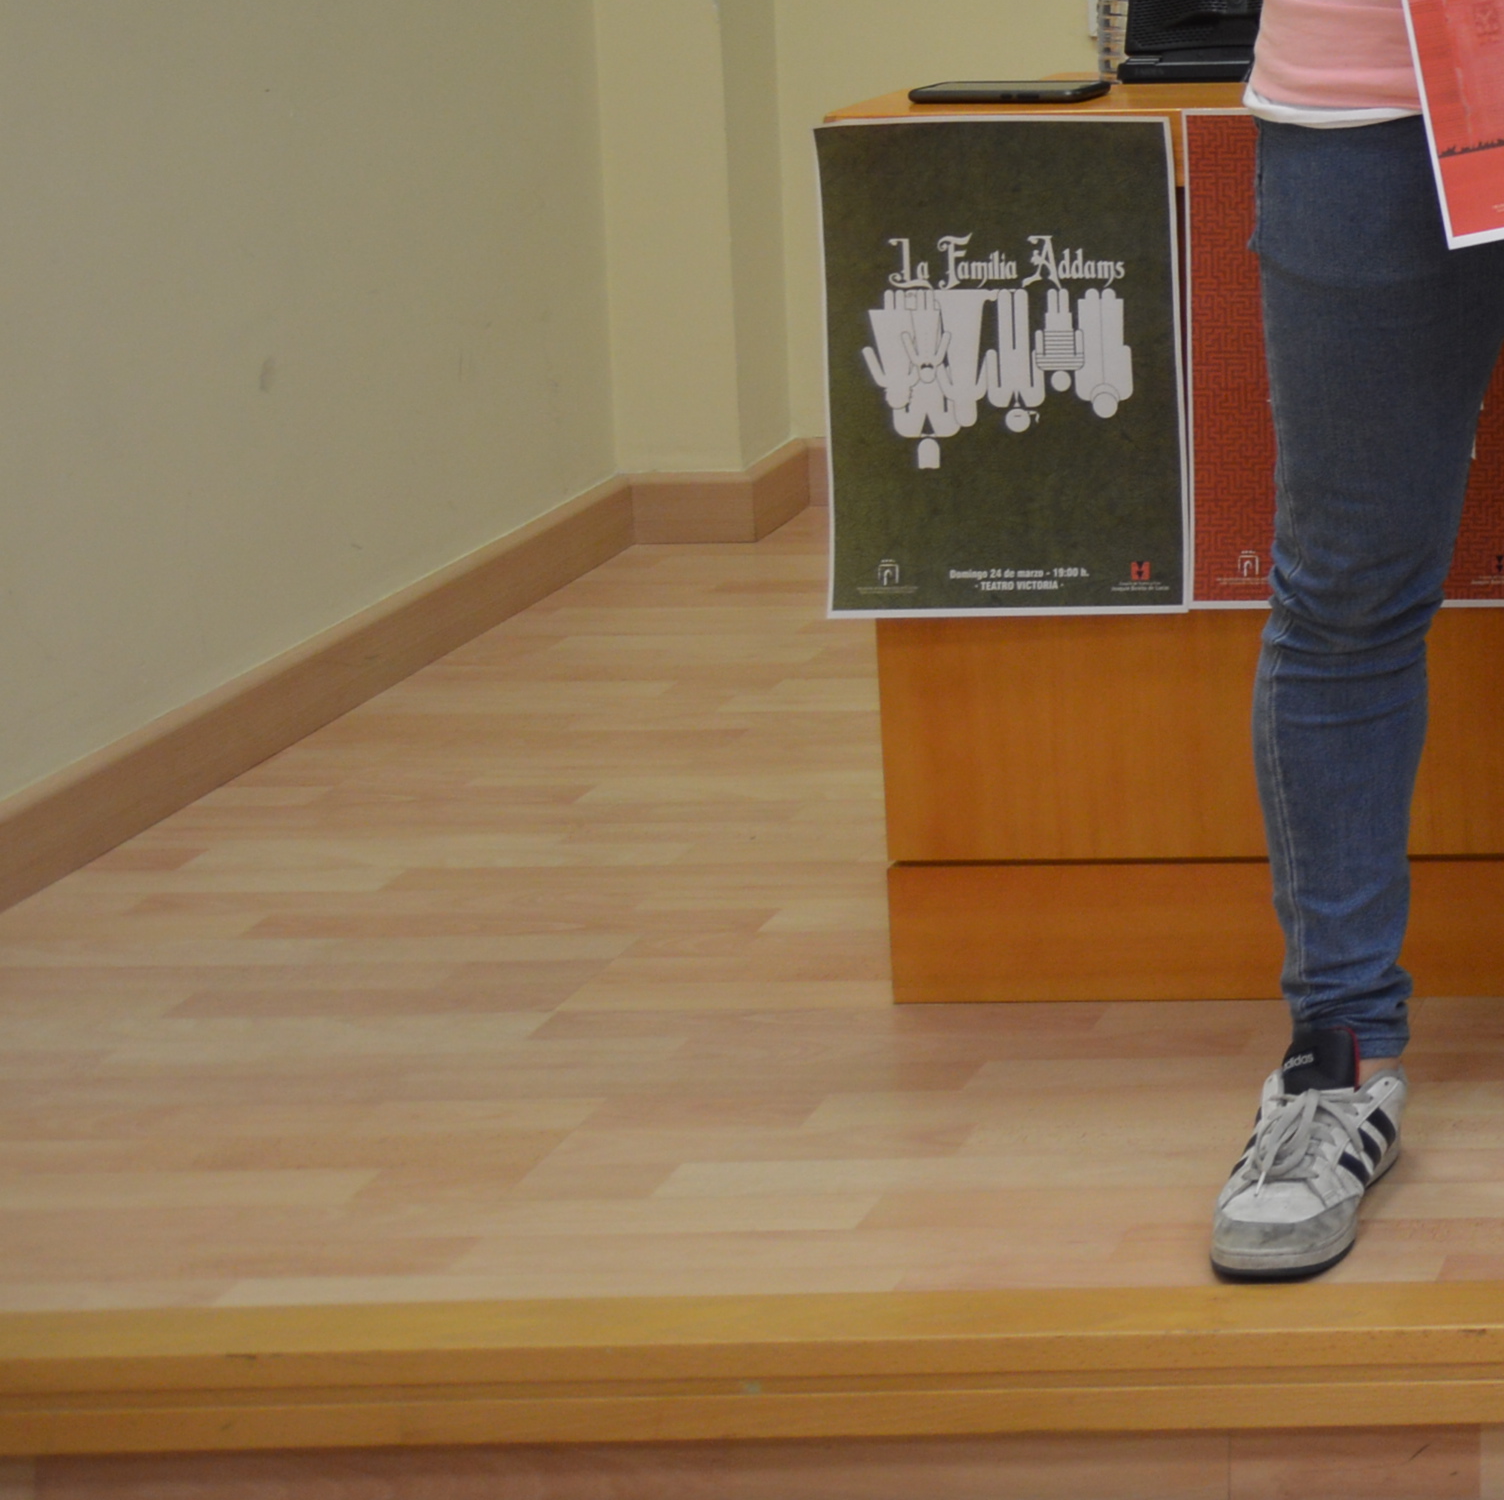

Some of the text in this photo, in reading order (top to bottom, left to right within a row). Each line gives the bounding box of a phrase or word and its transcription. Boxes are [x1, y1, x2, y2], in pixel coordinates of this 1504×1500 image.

[887, 232, 1126, 291] La Familia Addams
[949, 568, 988, 581] Domingo
[988, 567, 1002, 579] 24
[1003, 567, 1016, 579] de
[1017, 568, 1044, 579] marzo
[980, 579, 1059, 592] TEATRO VICTORIA
